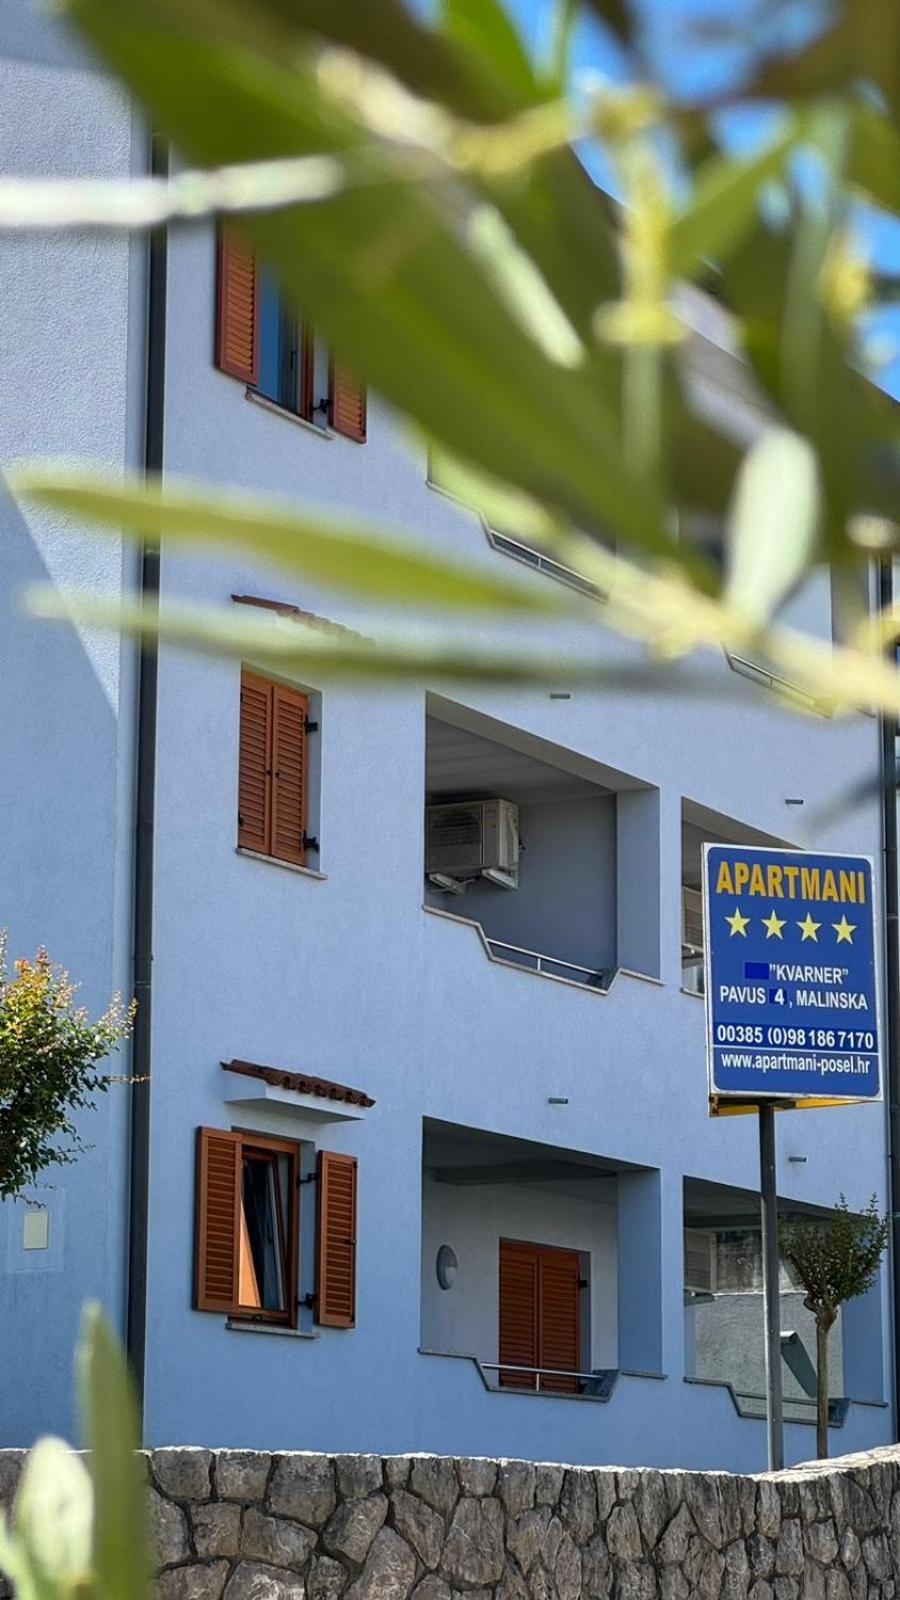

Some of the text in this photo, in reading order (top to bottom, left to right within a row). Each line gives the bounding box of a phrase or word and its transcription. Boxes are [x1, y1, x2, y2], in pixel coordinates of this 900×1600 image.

[716, 861, 865, 904] APARTMANI
[720, 985, 766, 1004] PAVUS
[796, 990, 868, 1010] MALINSKA
[717, 1024, 874, 1049] 00385 (0)98 186 7170
[721, 1053, 870, 1076] www.apartmani-posel.hr
